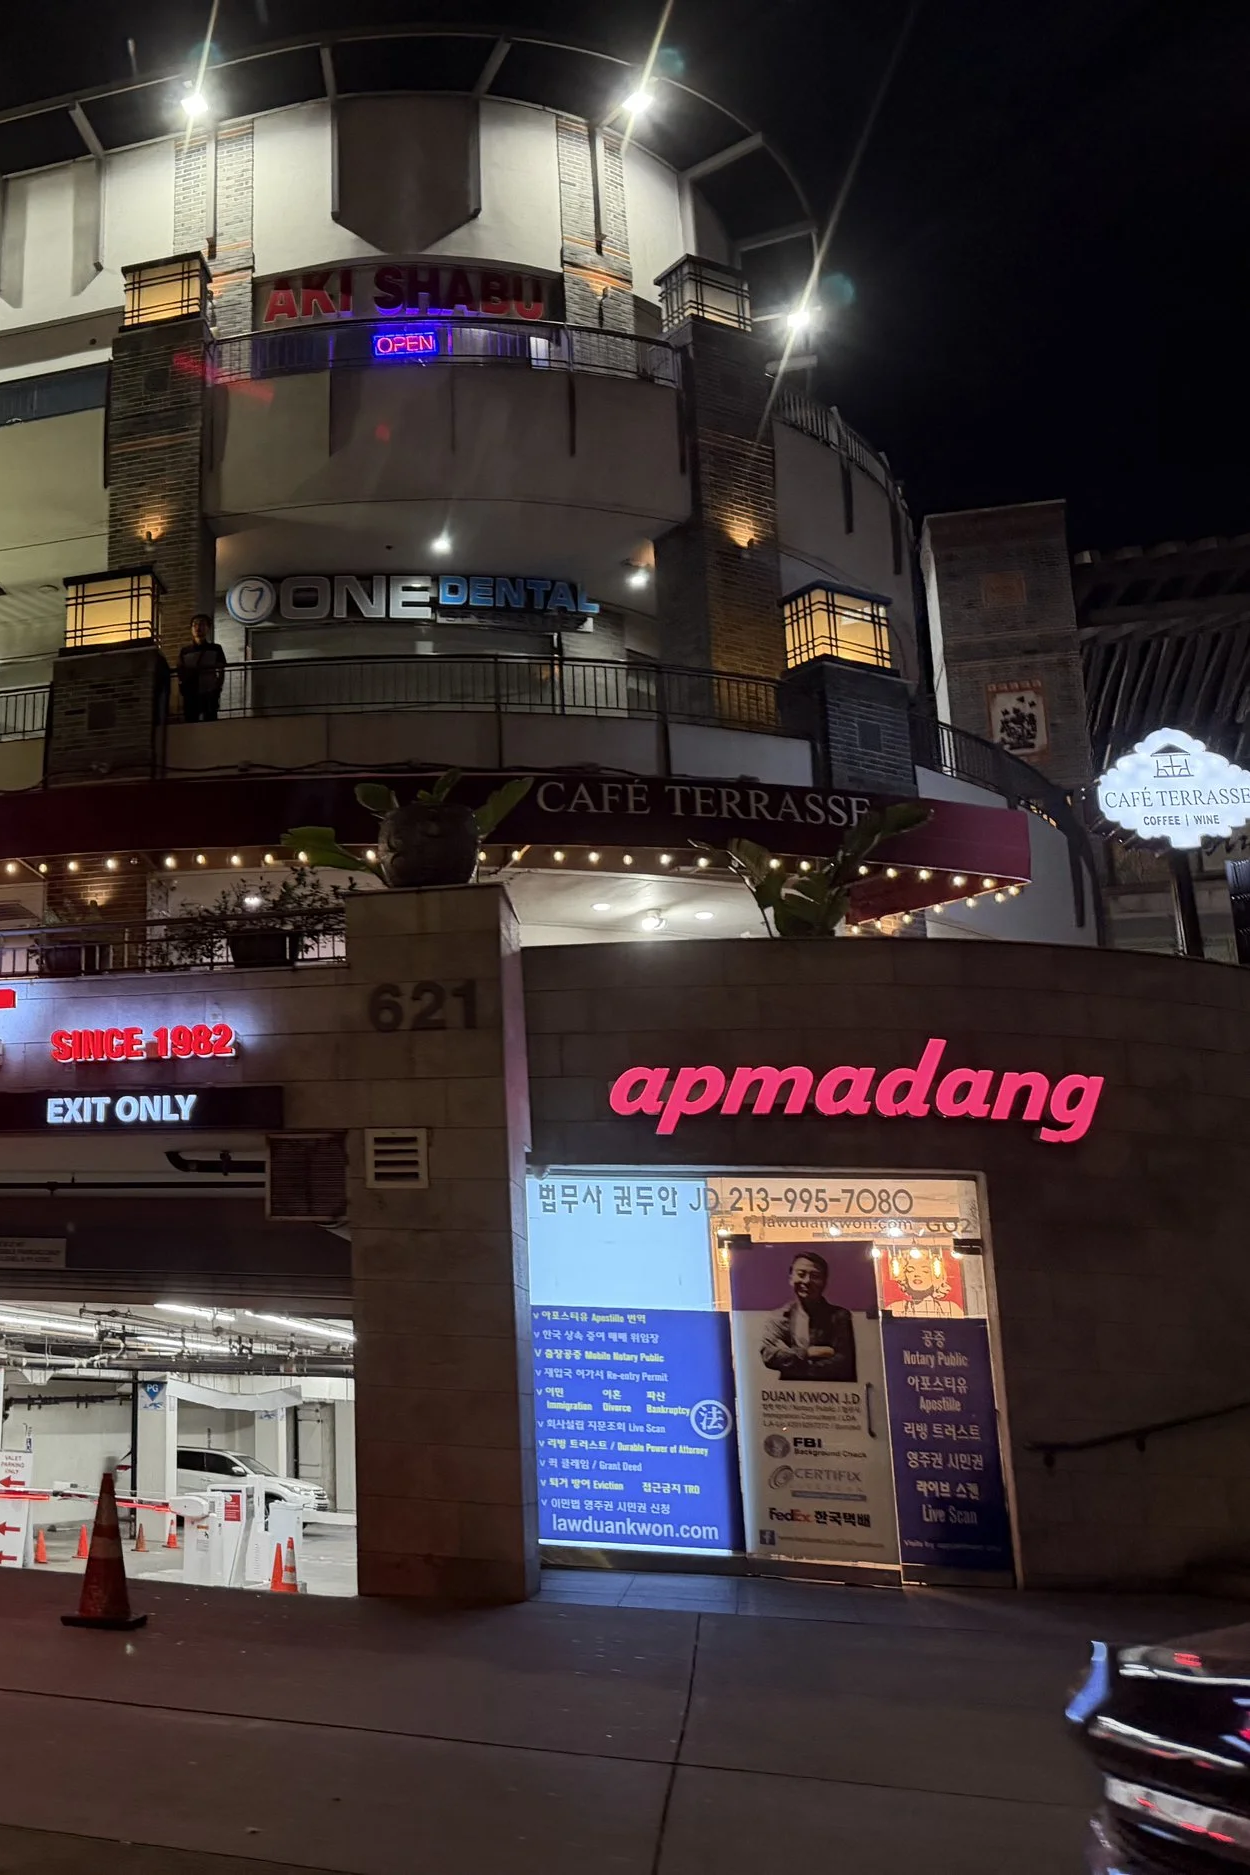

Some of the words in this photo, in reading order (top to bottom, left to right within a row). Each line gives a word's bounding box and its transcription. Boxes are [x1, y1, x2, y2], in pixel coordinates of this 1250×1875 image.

[264, 267, 353, 323] AKI
[373, 265, 544, 320] SHABU
[376, 334, 434, 355] OPEN
[279, 575, 432, 619] ONE
[438, 576, 600, 614] DENTAL
[537, 778, 651, 815] CAFÉ
[1104, 786, 1154, 809] CAFÉ
[1156, 788, 1250, 807] TERRASSE
[1143, 815, 1181, 826] COFFEE
[1193, 814, 1220, 825] WINE
[367, 979, 477, 1033] 621
[50, 1026, 146, 1063] SINCE
[153, 1023, 235, 1058] 1982
[609, 1038, 1104, 1144] apmadang
[46, 1096, 111, 1125] EXIT
[114, 1094, 198, 1123] ONLY
[538, 1184, 602, 1214] 법무사
[613, 1184, 678, 1217] 권두안
[688, 1187, 719, 1212] JD
[729, 1186, 914, 1215] 213-995-7080
[542, 1312, 588, 1322] 아포스티유
[922, 1330, 946, 1348] 공증
[613, 1352, 638, 1363] Notary
[640, 1353, 664, 1363] Public
[903, 1351, 935, 1368] Notary
[937, 1352, 968, 1367] Public
[607, 1371, 640, 1382] Re-entry
[642, 1372, 668, 1382] Permit
[907, 1375, 968, 1394] 아포스티유
[146, 1383, 159, 1393] PG
[761, 1390, 796, 1402] DUAN
[800, 1391, 840, 1404] KWON
[547, 1401, 592, 1412] Immigration
[602, 1402, 632, 1413] Divorce
[646, 1404, 690, 1417] Bankruptcy
[919, 1397, 961, 1413] Apostille
[698, 1405, 724, 1431] 法
[629, 1423, 644, 1433] Live
[646, 1423, 666, 1434] Scan
[903, 1422, 928, 1440] 리빙
[932, 1423, 981, 1441] 트러스트
[646, 1444, 668, 1453] Power
[679, 1445, 709, 1456] Attorney
[793, 1437, 823, 1448] FBI
[794, 1448, 840, 1457] Background
[907, 1451, 943, 1469] 영주권
[948, 1452, 983, 1471] 시민권
[599, 1461, 621, 1471] Grant
[623, 1462, 642, 1472] Deed
[794, 1468, 863, 1483] CERTIFIX
[593, 1480, 624, 1491] Eviction
[551, 1498, 580, 1510] 이민법
[584, 1500, 613, 1512] 영주권
[617, 1501, 647, 1513] 시민권
[650, 1503, 671, 1515] 신청
[922, 1504, 946, 1523] Live
[949, 1506, 978, 1525] Scan
[768, 1507, 812, 1523] FedEx
[814, 1510, 871, 1528] 한국택배
[552, 1514, 719, 1540] lawduankwon.com
